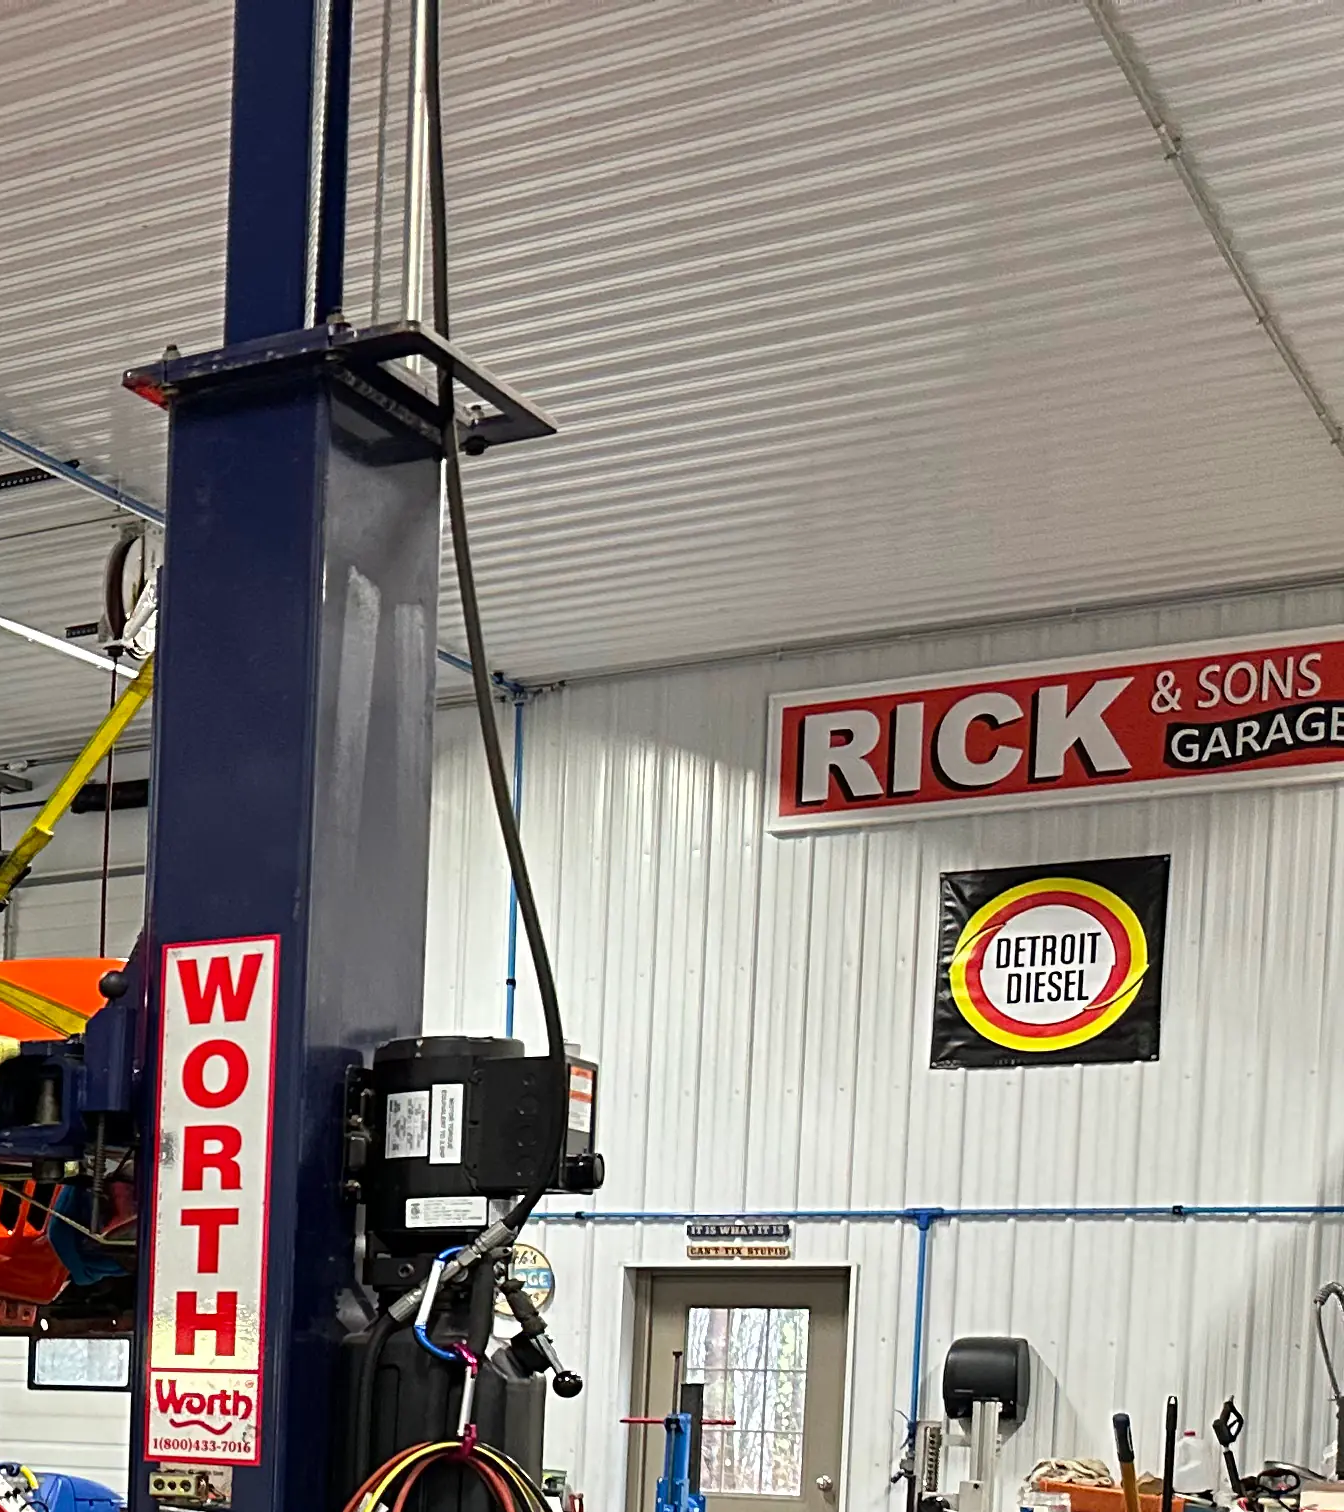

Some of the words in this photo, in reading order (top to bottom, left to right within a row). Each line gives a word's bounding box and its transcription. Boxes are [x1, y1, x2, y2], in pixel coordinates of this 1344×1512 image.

[800, 676, 1134, 806] RICK
[1150, 670, 1182, 714] &
[1197, 652, 1323, 709] SONS
[1170, 705, 1344, 764] GARAGE
[995, 931, 1102, 969] DETROIT
[1006, 968, 1090, 1004] DIESEL
[174, 952, 263, 1357] WORTH
[690, 1226, 703, 1235] IT
[705, 1226, 717, 1235] IS
[719, 1226, 756, 1235] WHAT
[757, 1226, 770, 1235] IT
[772, 1226, 784, 1235] IS
[748, 1247, 787, 1256] STUPID
[154, 1378, 252, 1419] Worth
[151, 1434, 252, 1455] 1(800)433-7016
